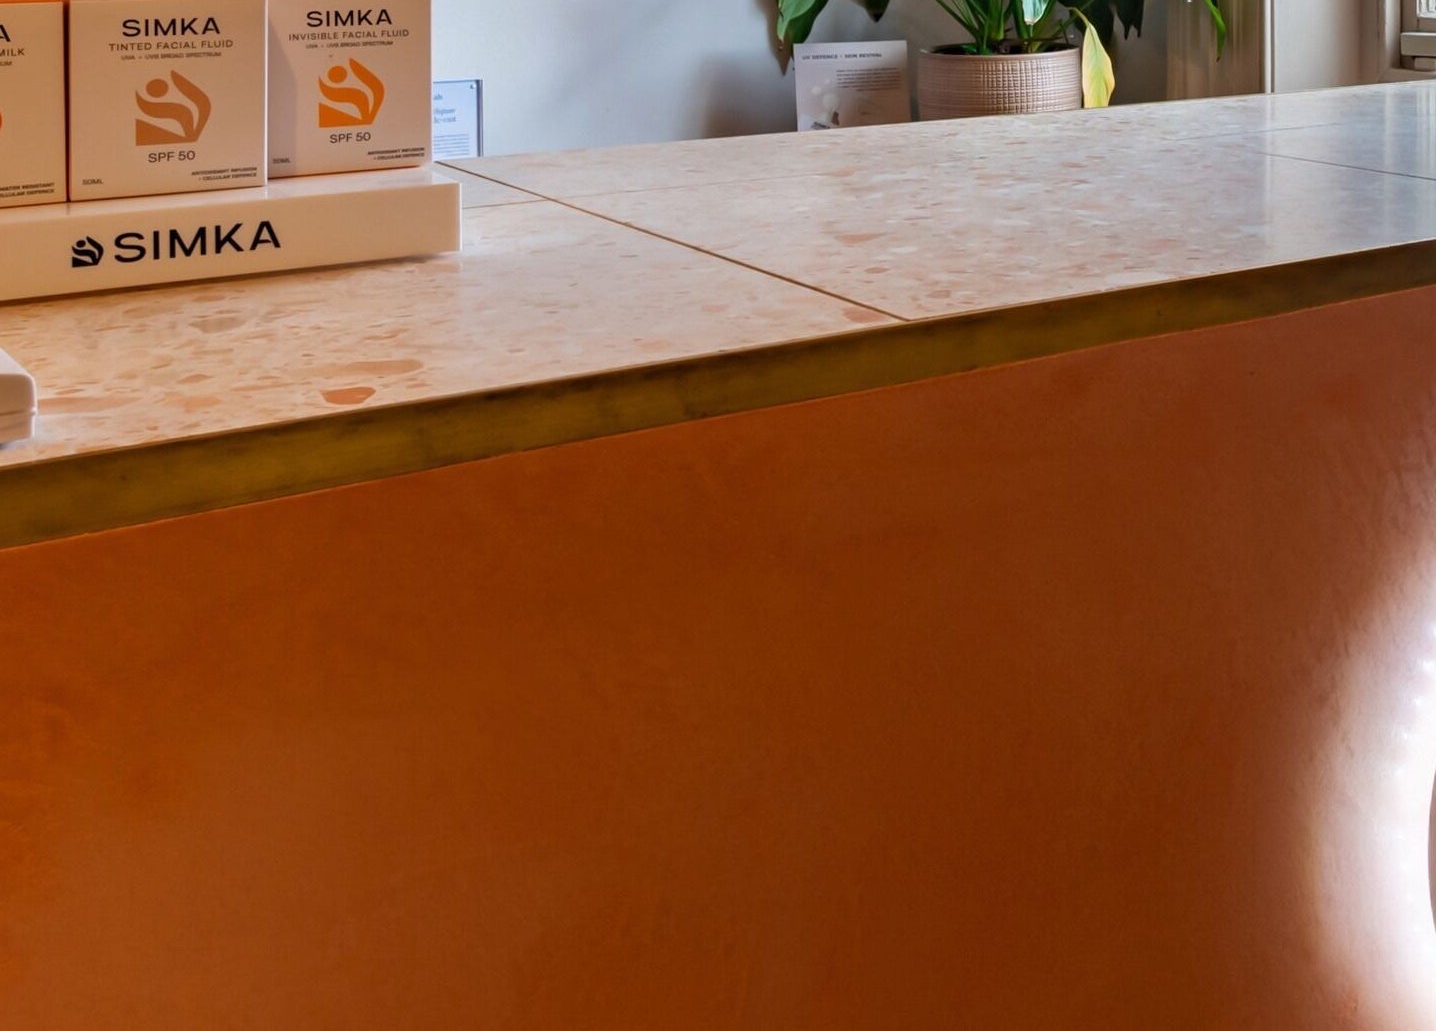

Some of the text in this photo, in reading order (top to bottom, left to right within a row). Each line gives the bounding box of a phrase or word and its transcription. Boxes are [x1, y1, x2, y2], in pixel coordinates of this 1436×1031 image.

[306, 9, 393, 28] SIMKA
[122, 17, 221, 37] SIMKA
[288, 29, 410, 41] INVISIBLE FACIAL FLUID
[108, 39, 234, 51] TINTED FACIAL FLUID
[329, 132, 372, 144] SPF 50
[148, 150, 196, 163] SPF 50
[113, 220, 282, 263] SIMKA
